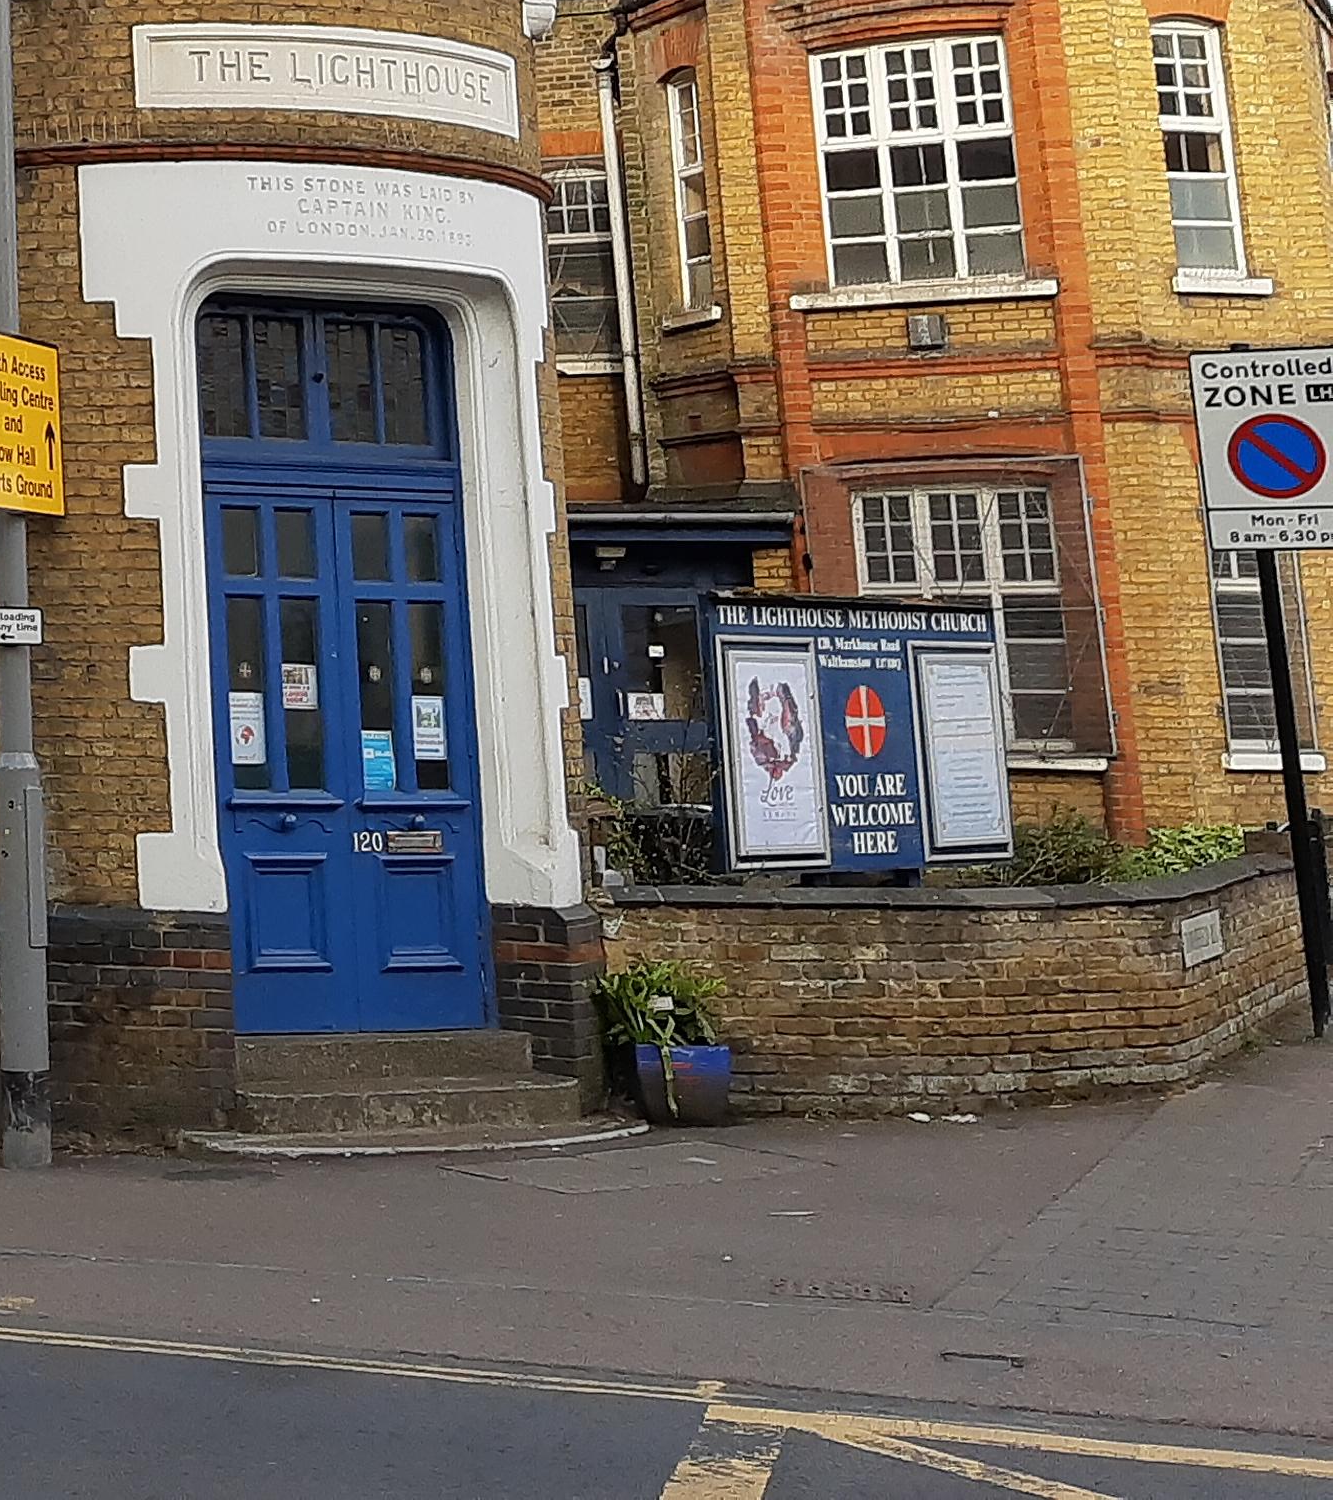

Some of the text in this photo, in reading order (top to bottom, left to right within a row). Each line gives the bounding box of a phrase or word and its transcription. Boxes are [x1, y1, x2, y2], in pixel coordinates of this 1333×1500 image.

[188, 50, 493, 105] THE LIGHTHOUSE
[247, 177, 294, 191] THIS
[304, 178, 366, 195] STONE
[375, 181, 412, 198] WAS
[419, 185, 452, 201] LAID
[298, 198, 390, 218] CAPTAIN
[267, 220, 287, 233] OF
[11, 356, 46, 382] Access
[1200, 356, 1333, 379] Controlled
[22, 386, 54, 411] Centre
[1203, 384, 1296, 407] ZONE
[4, 414, 23, 433] and
[17, 444, 36, 466] Hall
[16, 473, 53, 499] Ground
[1251, 514, 1285, 527] Mon
[1298, 513, 1319, 526] Fri
[1230, 531, 1240, 543] 8
[1244, 533, 1266, 543] am
[1279, 530, 1317, 543] 6.30
[1320, 532, 1333, 544] p
[0, 612, 35, 622] loading
[16, 623, 38, 631] time
[716, 605, 987, 632] THE LIGHTHOUSE METHODIST CHURCH
[760, 784, 794, 807] Love
[835, 773, 906, 797] YOU ARE
[831, 802, 915, 827] WELCOME
[353, 831, 383, 852] 120
[853, 831, 898, 855] HERE
